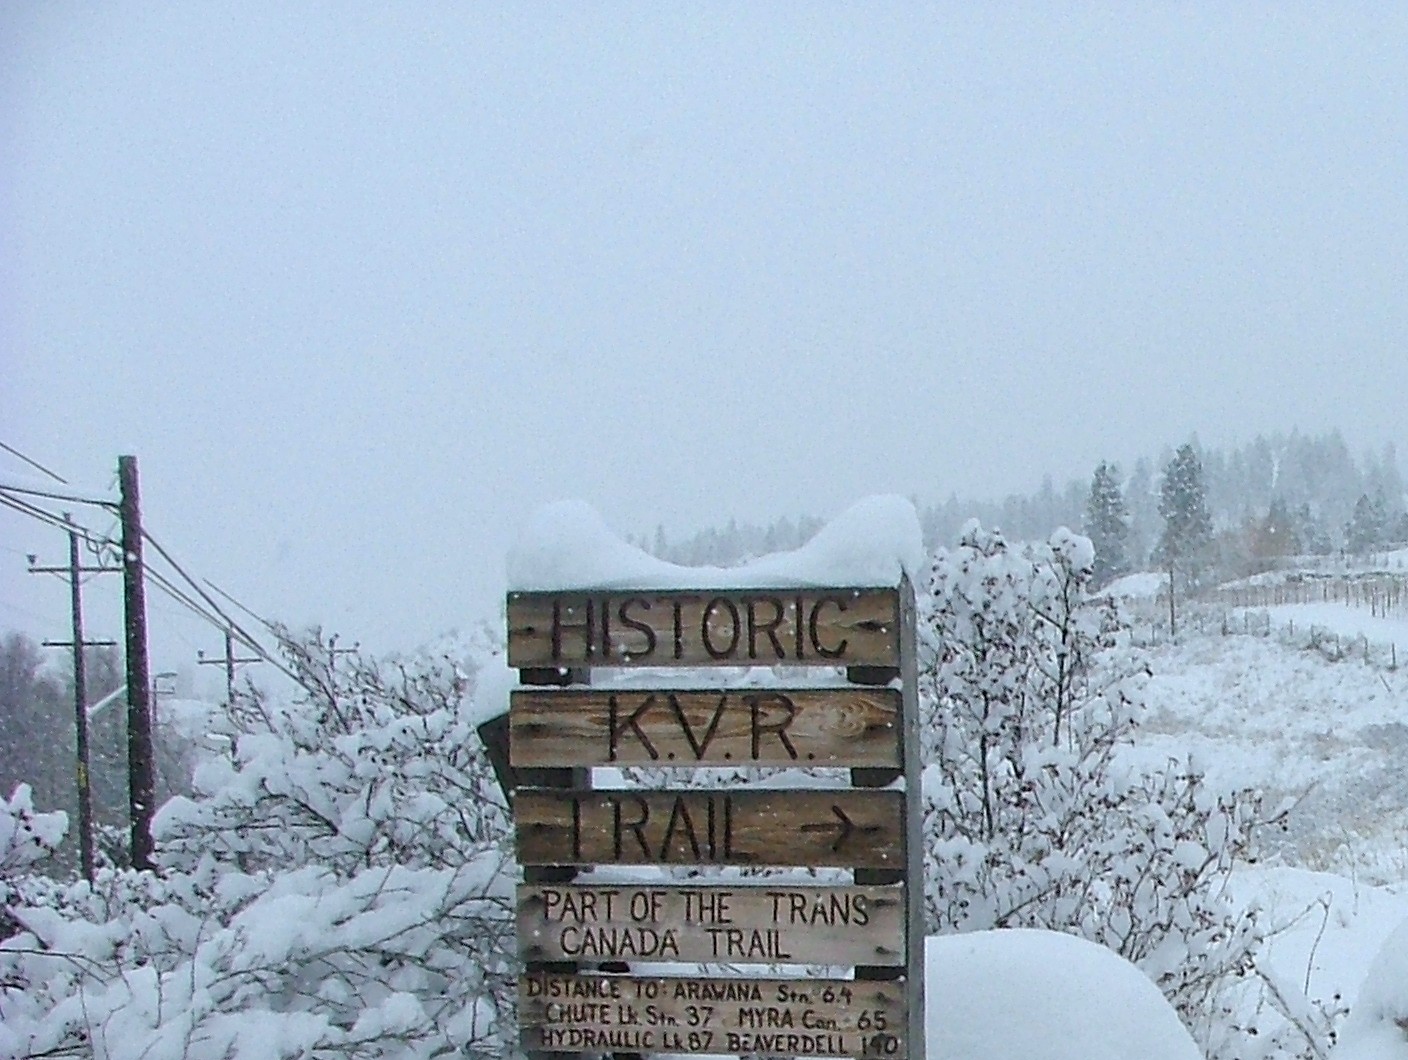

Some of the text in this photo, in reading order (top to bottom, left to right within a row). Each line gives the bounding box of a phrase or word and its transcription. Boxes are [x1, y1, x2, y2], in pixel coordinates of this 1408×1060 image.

[552, 597, 848, 660] HISTORIC
[541, 890, 869, 926] PART OF THE TRANS
[560, 928, 791, 958] CANADA TRAIL
[526, 978, 620, 999] DISTANCE
[673, 983, 762, 1003] ARAWANA
[546, 1002, 610, 1024] CHUTE
[686, 1006, 714, 1028] 37
[739, 1007, 794, 1028] MYRA
[857, 1011, 887, 1030] 65
[541, 1029, 655, 1048] HYDRAULIC
[688, 1032, 713, 1051] 87
[727, 1033, 848, 1054] BEAVERDELL
